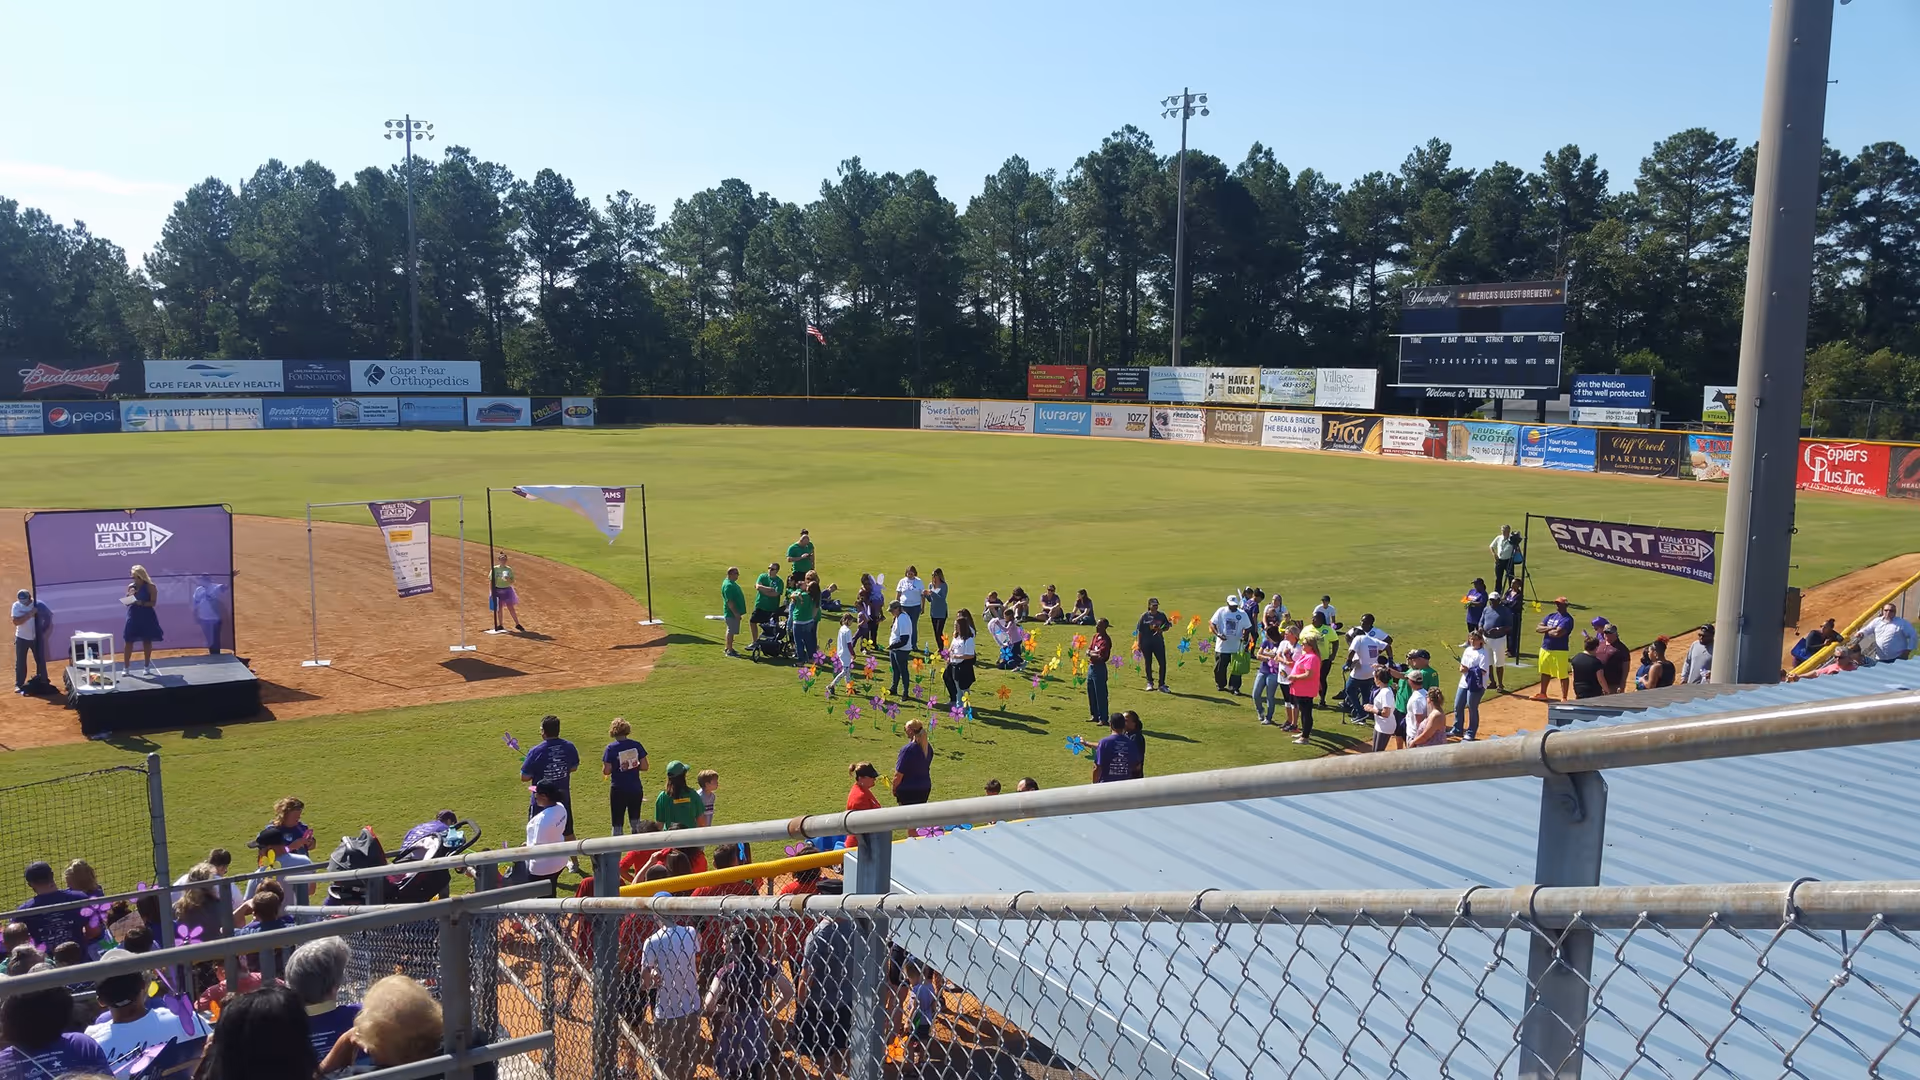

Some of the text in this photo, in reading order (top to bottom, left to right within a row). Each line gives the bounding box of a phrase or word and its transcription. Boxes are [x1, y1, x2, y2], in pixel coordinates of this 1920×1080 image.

[1407, 290, 1450, 306] Yuengling
[1468, 291, 1498, 300] AMERICA'S
[1500, 290, 1522, 299] OLDEST
[1410, 336, 1422, 344] TIME
[389, 366, 446, 376] Cape Fear
[18, 369, 120, 384] Budweiser
[288, 372, 346, 381] FOUNDATION
[1228, 376, 1255, 385] HAVE A
[1323, 371, 1354, 387] Village
[390, 376, 469, 388] Orthopedics
[1228, 386, 1254, 395] BLONDE
[1324, 384, 1366, 394] family dental
[1426, 388, 1456, 397] Welcome
[1468, 388, 1487, 398] THE
[1489, 389, 1525, 399] SWAMP
[1609, 390, 1647, 398] protected.
[149, 408, 259, 417] LUMBEE RIVER EMC
[927, 406, 979, 415] Sweet Tooth
[1040, 408, 1086, 423] kuraray
[72, 410, 114, 424] pepsi
[1009, 406, 1029, 427] 55
[1095, 417, 1112, 426] 95.7
[1128, 413, 1148, 422] 107.7
[1215, 410, 1252, 424] Flooring
[1215, 422, 1253, 432] America
[1325, 419, 1365, 444] FTCC
[1478, 428, 1511, 436] BUDGET
[1472, 434, 1515, 443] ROOTER
[1522, 444, 1544, 452] Comfort
[1548, 446, 1562, 454] Away
[1612, 437, 1665, 454] Cliff Creek
[1603, 455, 1676, 465] APARTMENTS
[1805, 443, 1868, 471] Copiers
[1844, 470, 1865, 486] Inc.
[1842, 484, 1853, 492] for
[96, 521, 145, 532] WALK TO
[98, 532, 146, 543] END
[1550, 523, 1655, 554] START
[1660, 535, 1683, 544] WALK
[1661, 542, 1695, 551] END
[1577, 547, 1593, 555] END
[1607, 555, 1660, 569] ALZHEIMER'S
[1661, 563, 1691, 574] STARTS
[1693, 569, 1713, 580] HERE
